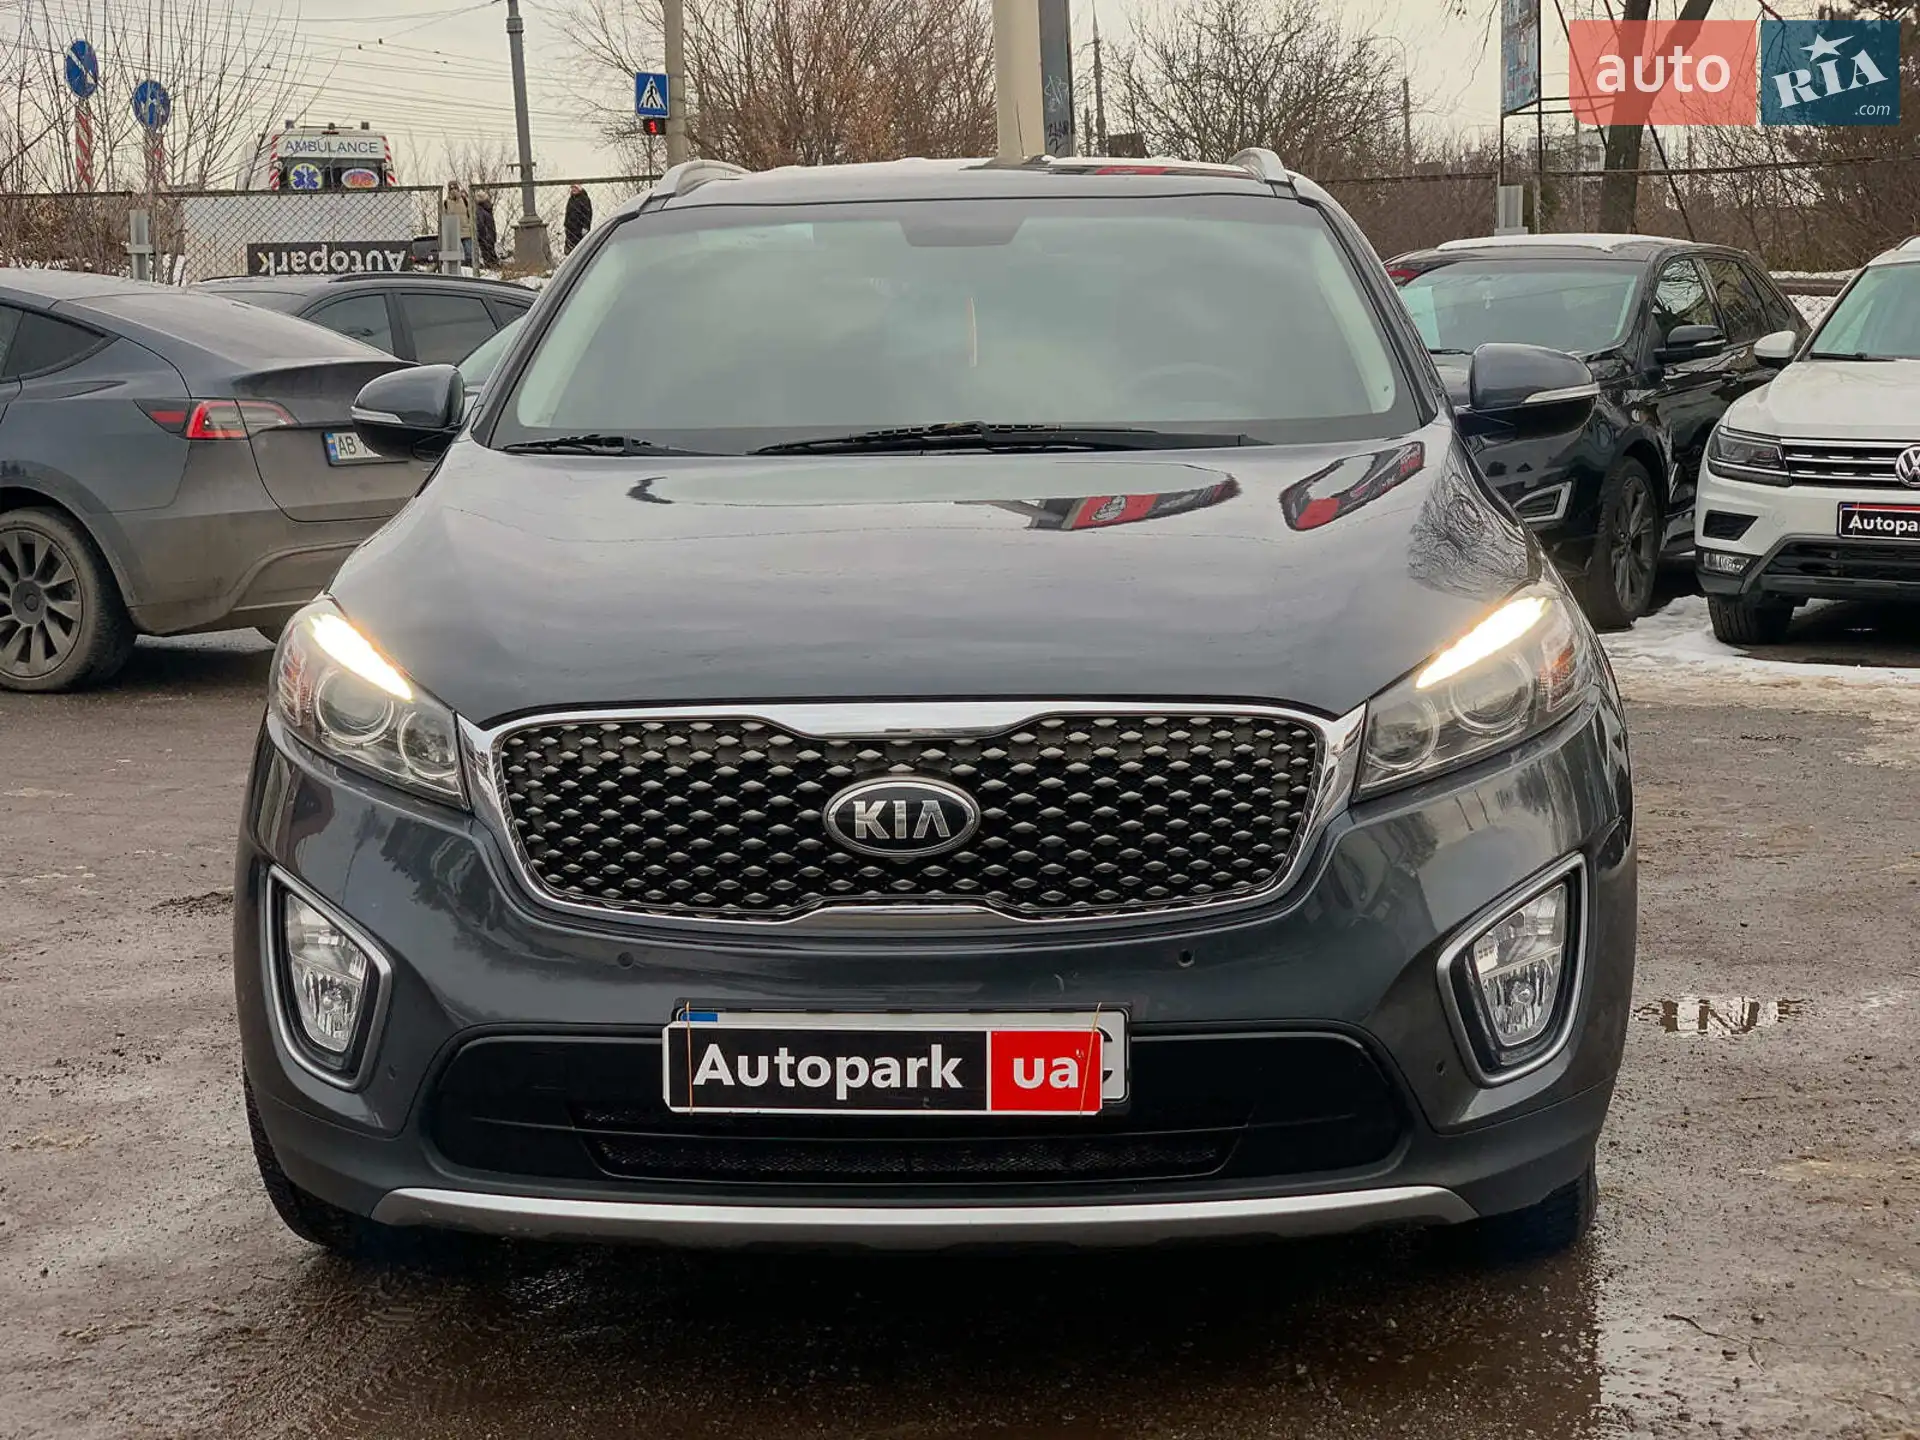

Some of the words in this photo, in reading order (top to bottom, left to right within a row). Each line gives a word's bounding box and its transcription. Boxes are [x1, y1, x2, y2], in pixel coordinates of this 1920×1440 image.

[285, 140, 379, 153] AMBULANCE
[257, 244, 406, 276] Autopark
[338, 435, 357, 457] AB
[1848, 514, 1920, 535] Autopa
[853, 800, 951, 840] KIA
[692, 1043, 964, 1101] Autopark
[1012, 1056, 1079, 1089] ua
